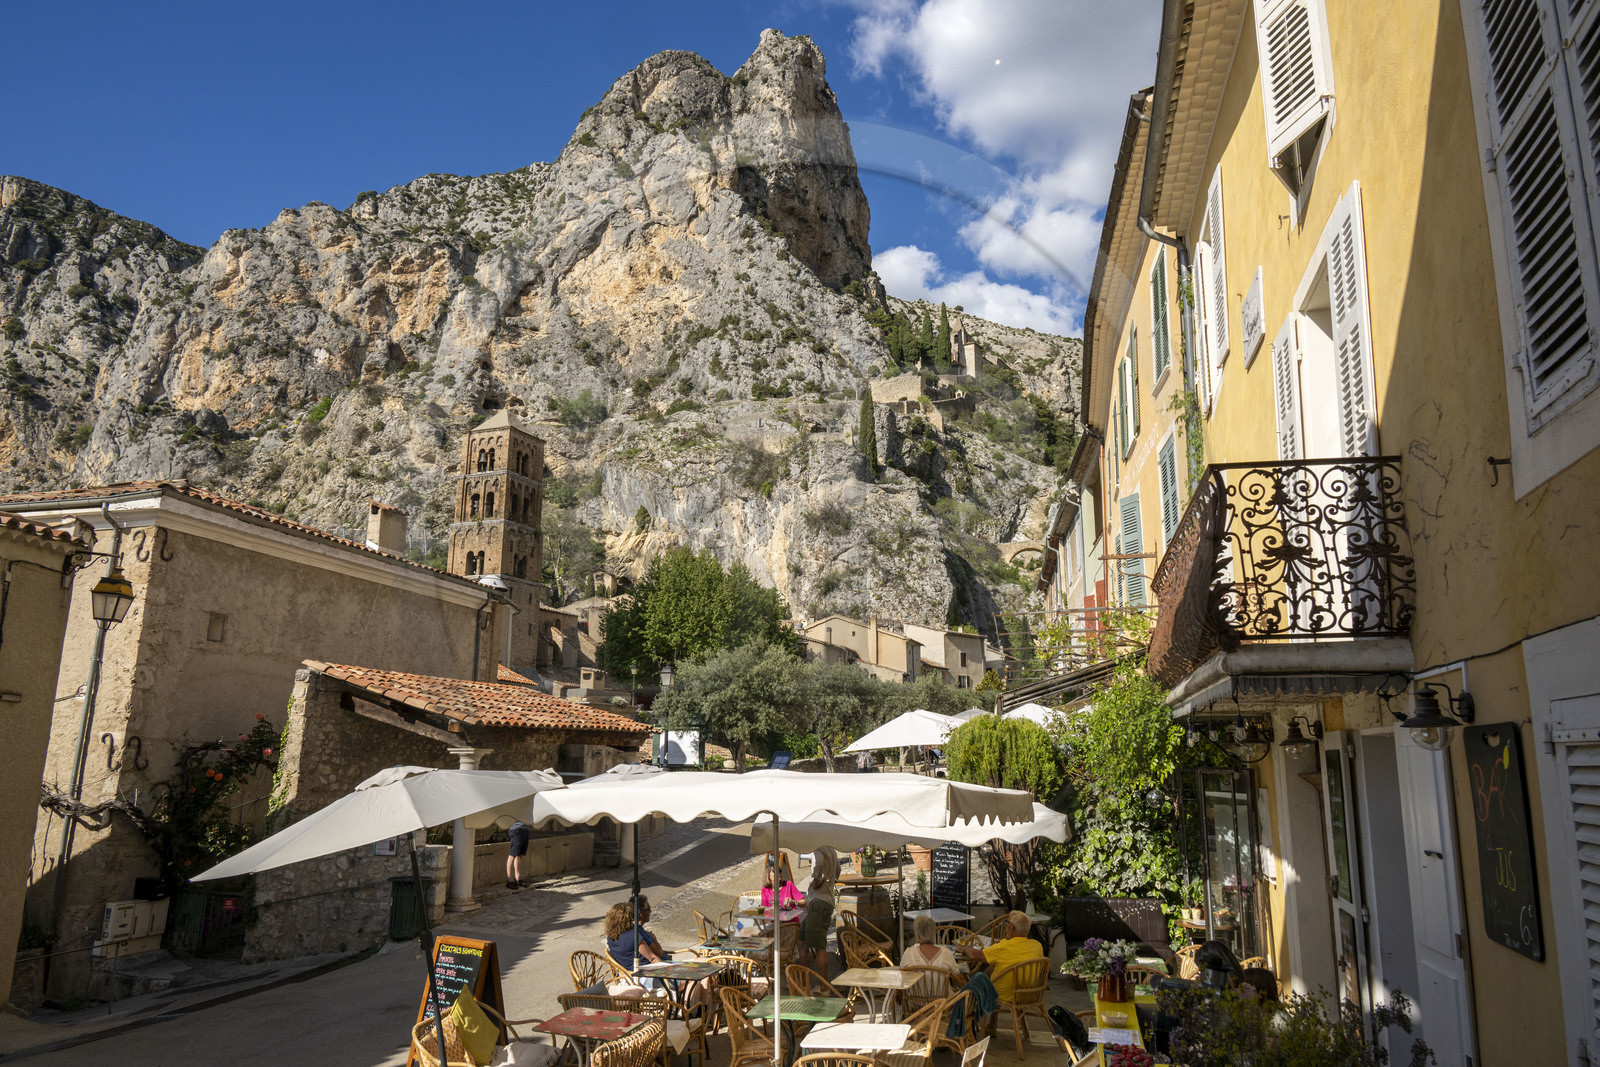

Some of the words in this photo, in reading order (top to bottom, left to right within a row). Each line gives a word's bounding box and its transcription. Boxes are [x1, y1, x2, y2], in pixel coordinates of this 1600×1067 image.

[1472, 757, 1518, 824] BAR
[1496, 848, 1516, 891] JUS
[440, 944, 462, 954] COCKTAILS
[462, 947, 483, 957] SIGNATURE
